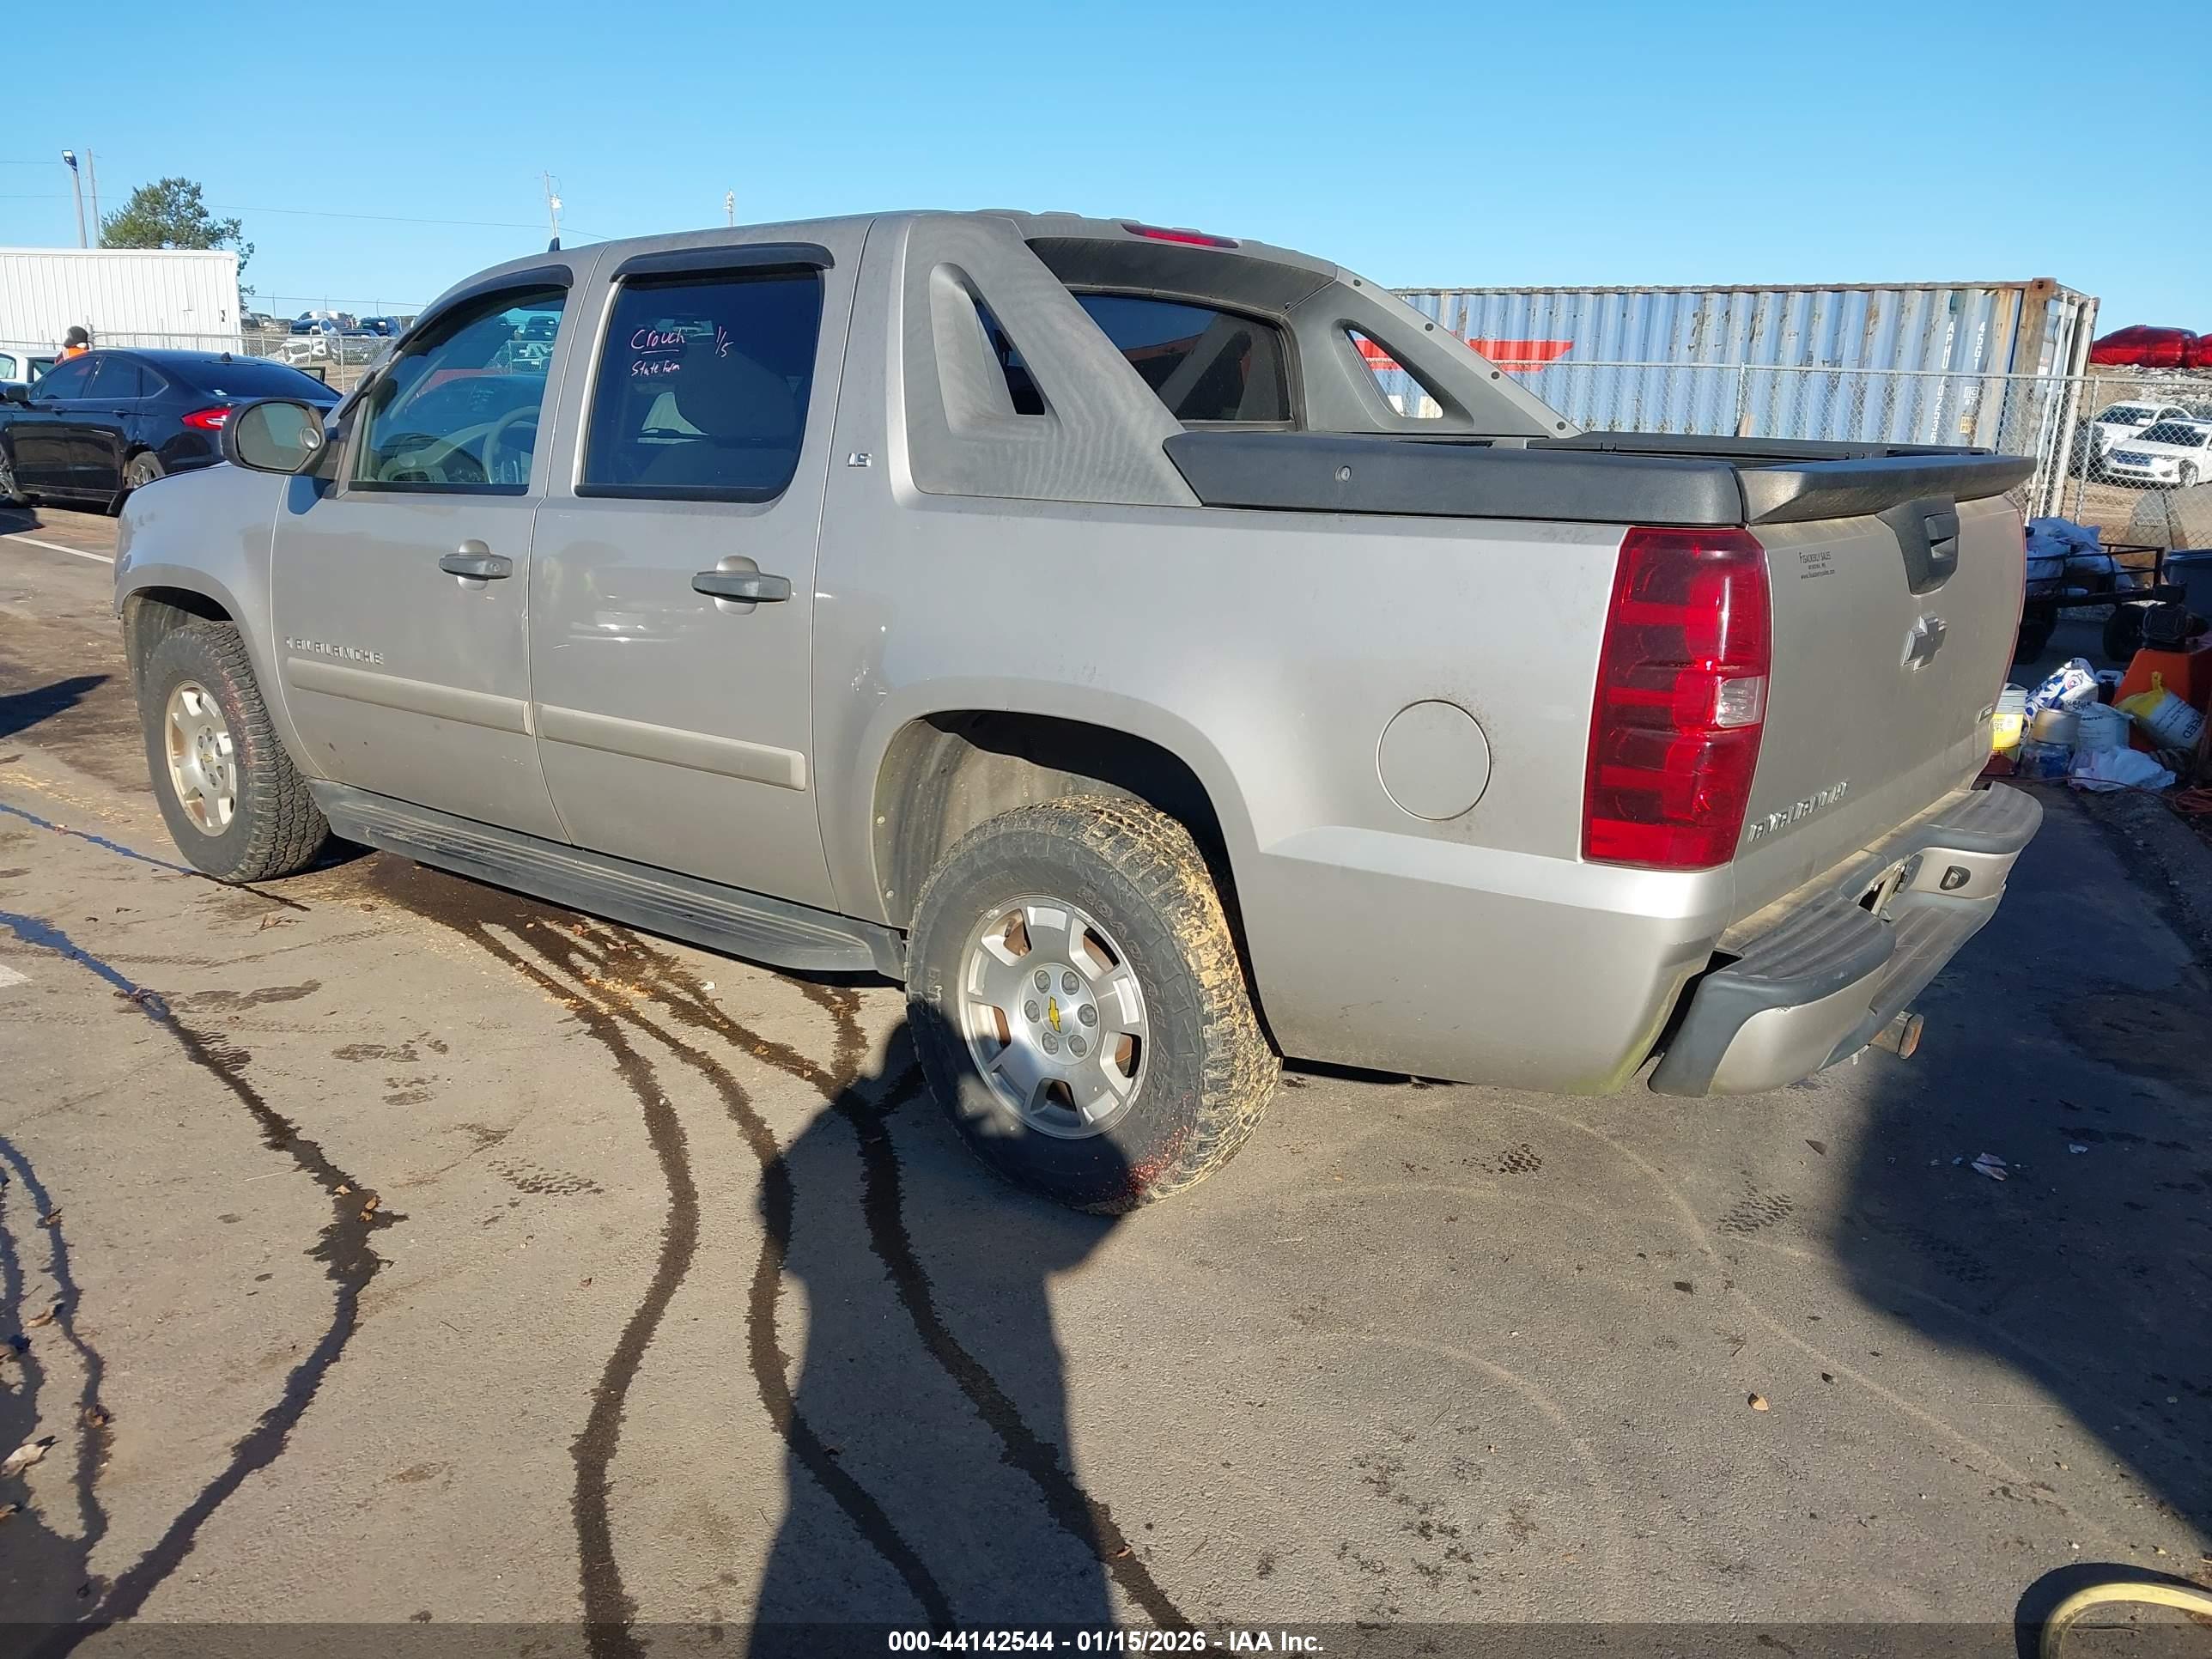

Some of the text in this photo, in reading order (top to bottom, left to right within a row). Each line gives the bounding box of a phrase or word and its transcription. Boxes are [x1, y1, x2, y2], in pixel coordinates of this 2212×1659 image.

[630, 325, 734, 358] Crouch 1/5
[1942, 321, 1954, 369] APHU
[631, 360, 659, 377] State
[848, 453, 872, 467] LS
